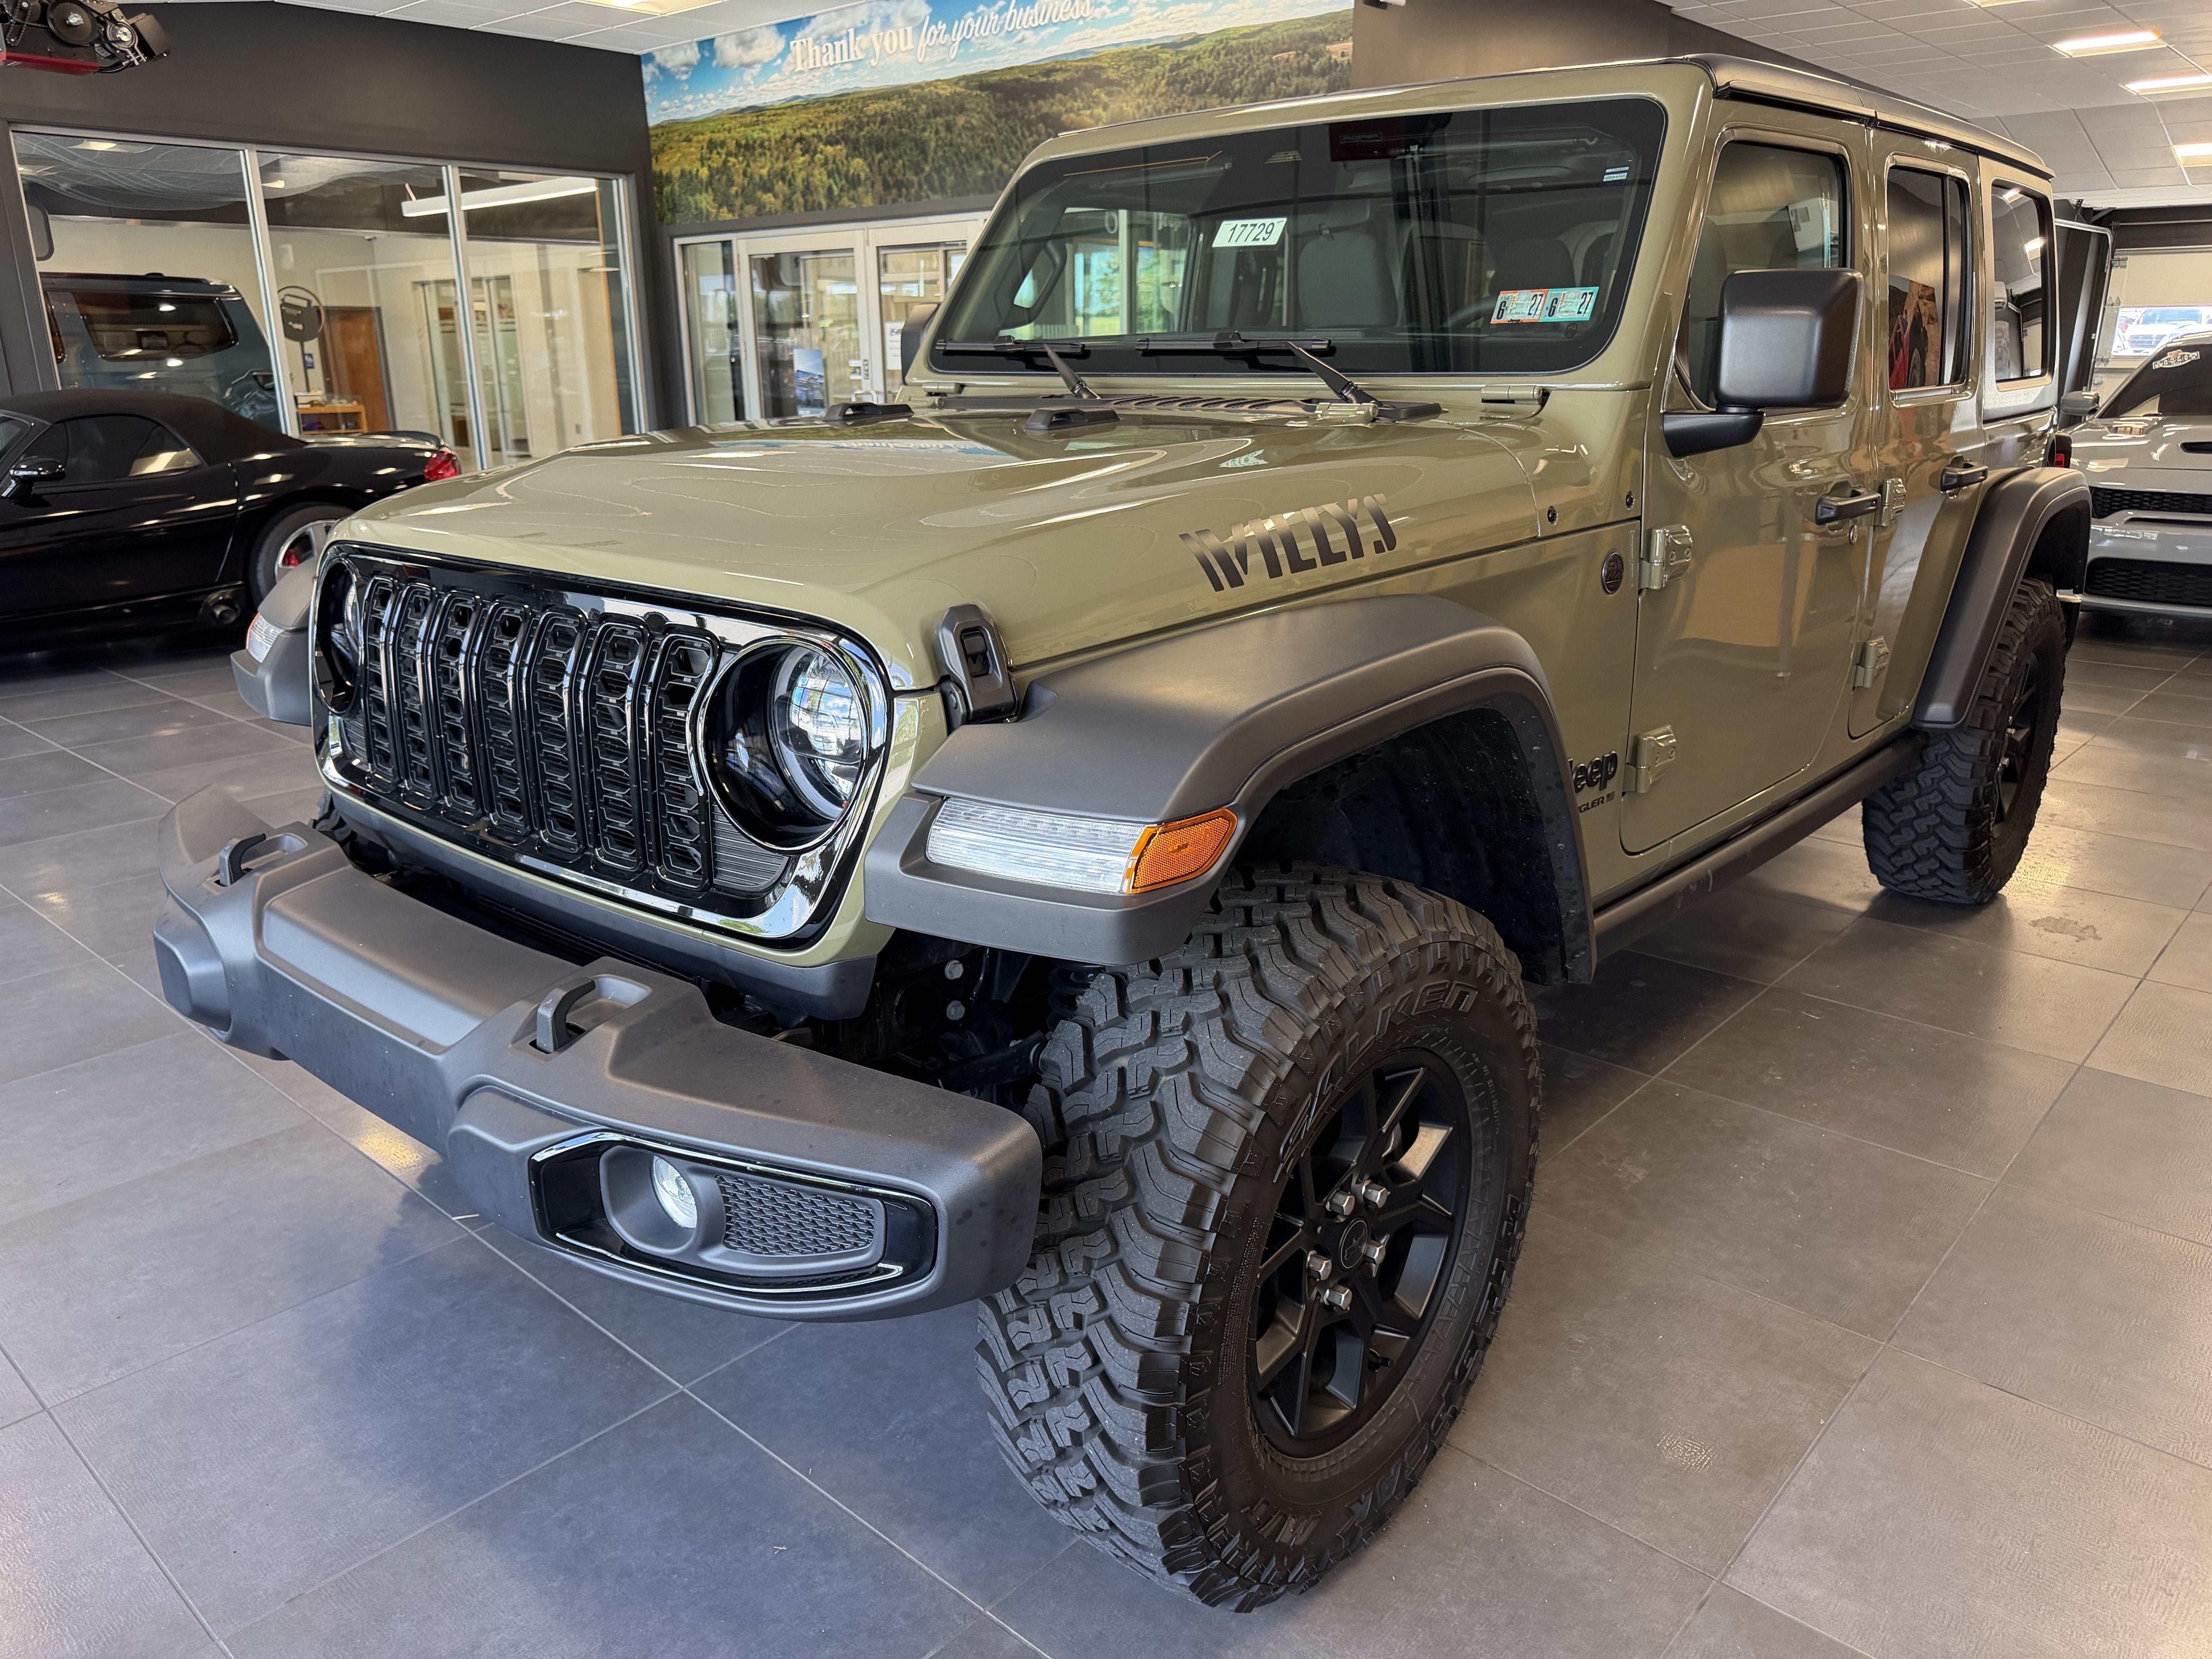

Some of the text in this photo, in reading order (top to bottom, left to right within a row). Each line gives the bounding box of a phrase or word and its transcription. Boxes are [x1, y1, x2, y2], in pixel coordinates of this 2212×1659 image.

[790, 0, 1095, 72] Thank you for your business
[1228, 222, 1274, 243] 17729
[1496, 294, 1544, 320] 6 27
[1548, 292, 1594, 317] 6 27
[1179, 493, 1396, 592] WILLYS
[1578, 796, 1604, 813] GLER
